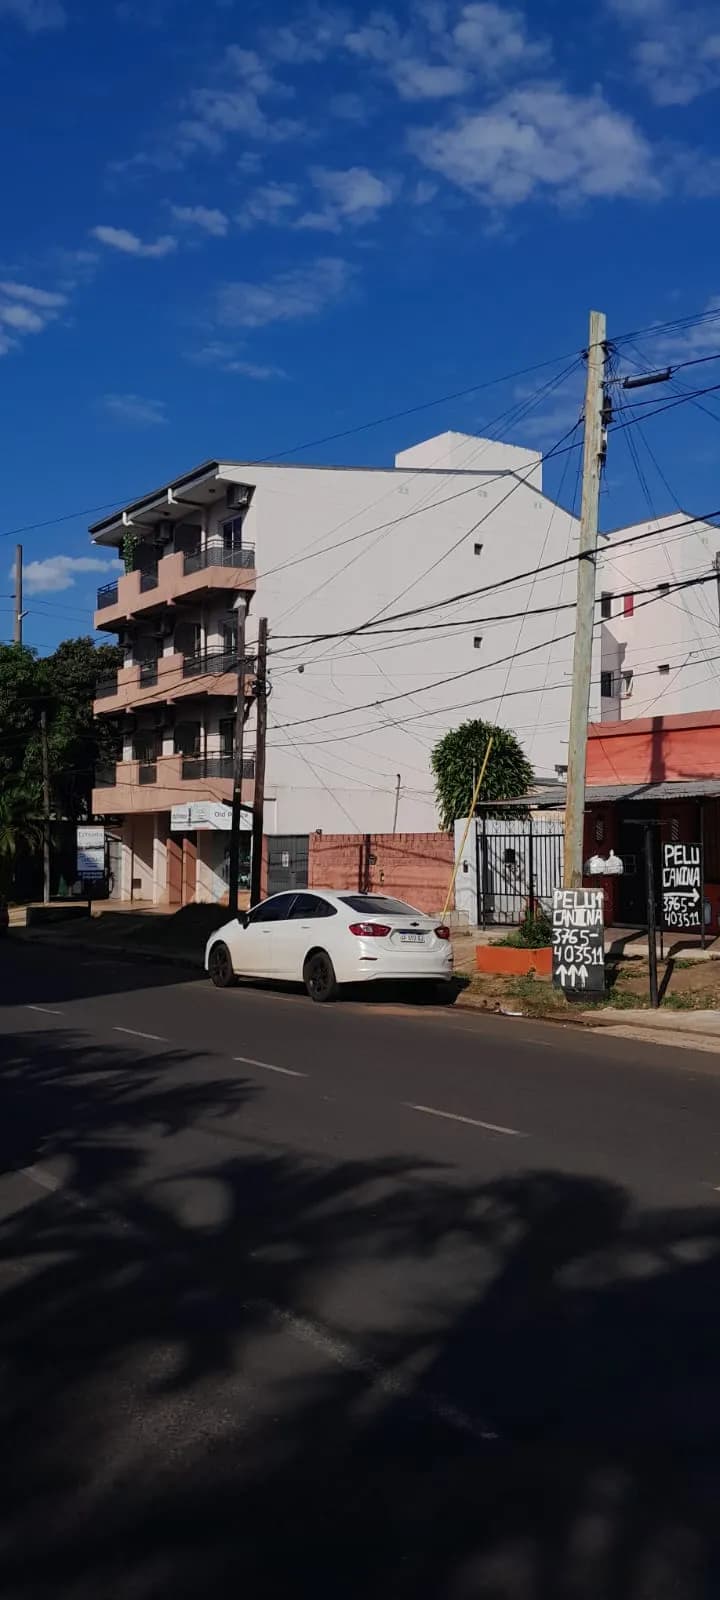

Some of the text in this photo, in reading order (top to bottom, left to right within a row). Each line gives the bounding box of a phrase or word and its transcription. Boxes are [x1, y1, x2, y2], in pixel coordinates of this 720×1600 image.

[664, 844, 700, 867] PELU
[662, 866, 700, 887] CANINA
[553, 890, 596, 909] PELU
[663, 896, 696, 913] 3765-
[552, 908, 603, 927] CANINA
[664, 911, 701, 927] 403511
[552, 928, 599, 947] 3765-
[553, 945, 604, 965] 403511
